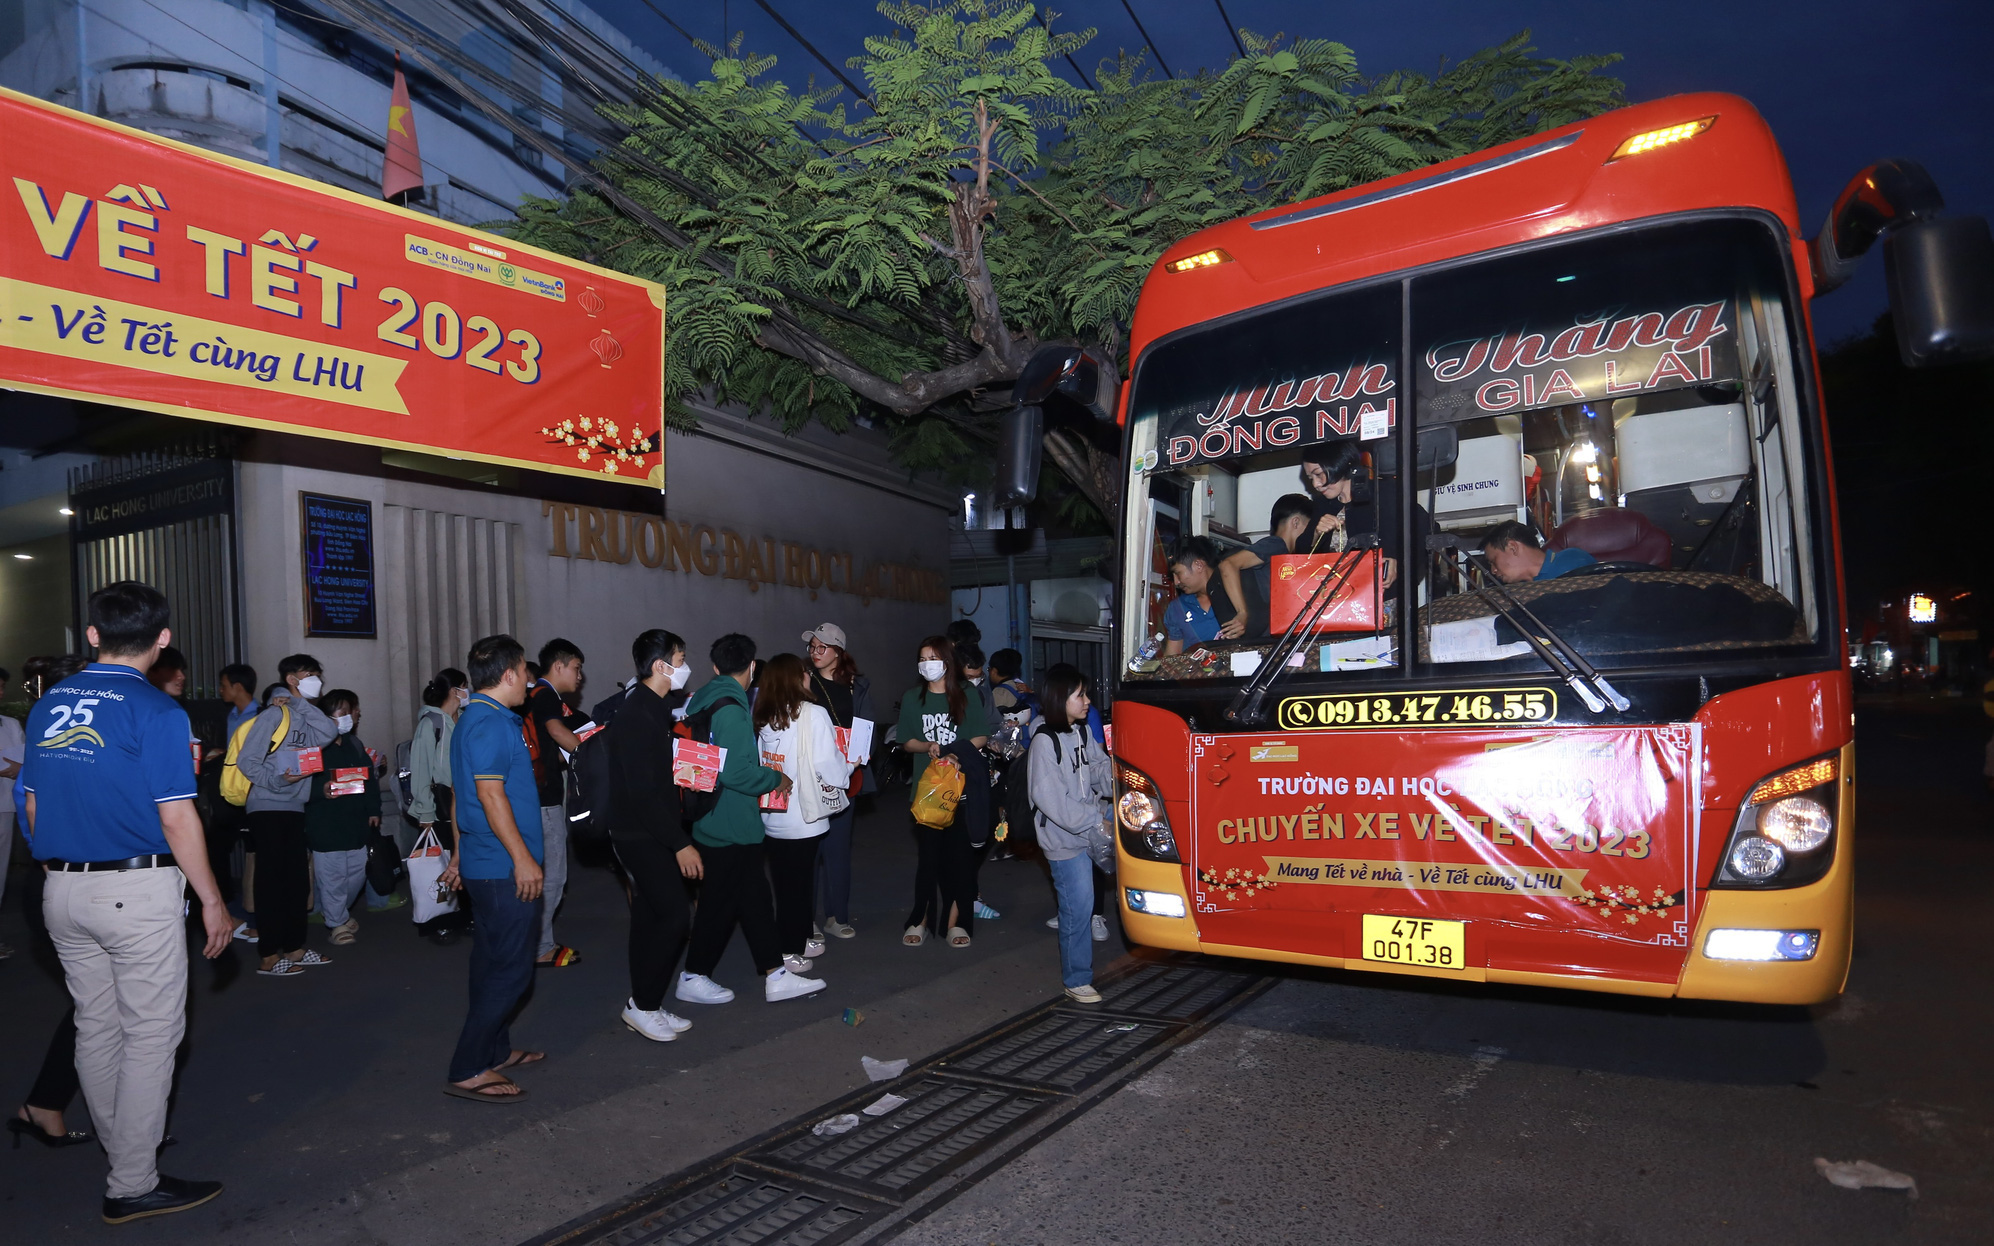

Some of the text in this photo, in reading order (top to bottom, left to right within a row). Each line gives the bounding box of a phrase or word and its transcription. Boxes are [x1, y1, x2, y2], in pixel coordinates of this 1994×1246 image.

[409, 244, 428, 256] ACB
[435, 251, 449, 262] CN
[476, 263, 491, 274] Nai
[12, 176, 543, 385] VỀ TẾT 2023
[51, 304, 107, 344] Về
[121, 318, 179, 358] Tết
[189, 336, 282, 383] cùng
[292, 353, 365, 392] LHU
[1197, 357, 1396, 426] Minh
[1475, 345, 1713, 411] GIA LAI
[1167, 416, 1301, 466] ĐỒNG
[1316, 398, 1396, 440] NAI
[86, 477, 225, 525] LAC HONG UNIVERSITY
[1457, 483, 1474, 493] SINH
[1475, 479, 1499, 490] CHUNG
[44, 698, 100, 738] 25
[1317, 693, 1547, 725] 0913.47.46.55
[1258, 772, 1349, 795] TRƯỜNG
[1354, 777, 1395, 800] ĐẠI
[1402, 777, 1453, 801] HỌC
[1217, 803, 1346, 845] CHUYẾN
[1353, 813, 1401, 840] XE
[1550, 821, 1651, 859] 2023
[1277, 862, 1319, 881] Mang
[1324, 863, 1347, 879] Tết
[1350, 864, 1368, 879] về
[1371, 867, 1403, 882] nhà
[1420, 866, 1441, 884] Về
[1446, 868, 1470, 885] Tết
[1474, 868, 1517, 891] cùng
[1523, 872, 1563, 890] LHU
[1391, 919, 1434, 940] 47F
[1374, 940, 1452, 965] 001.38
